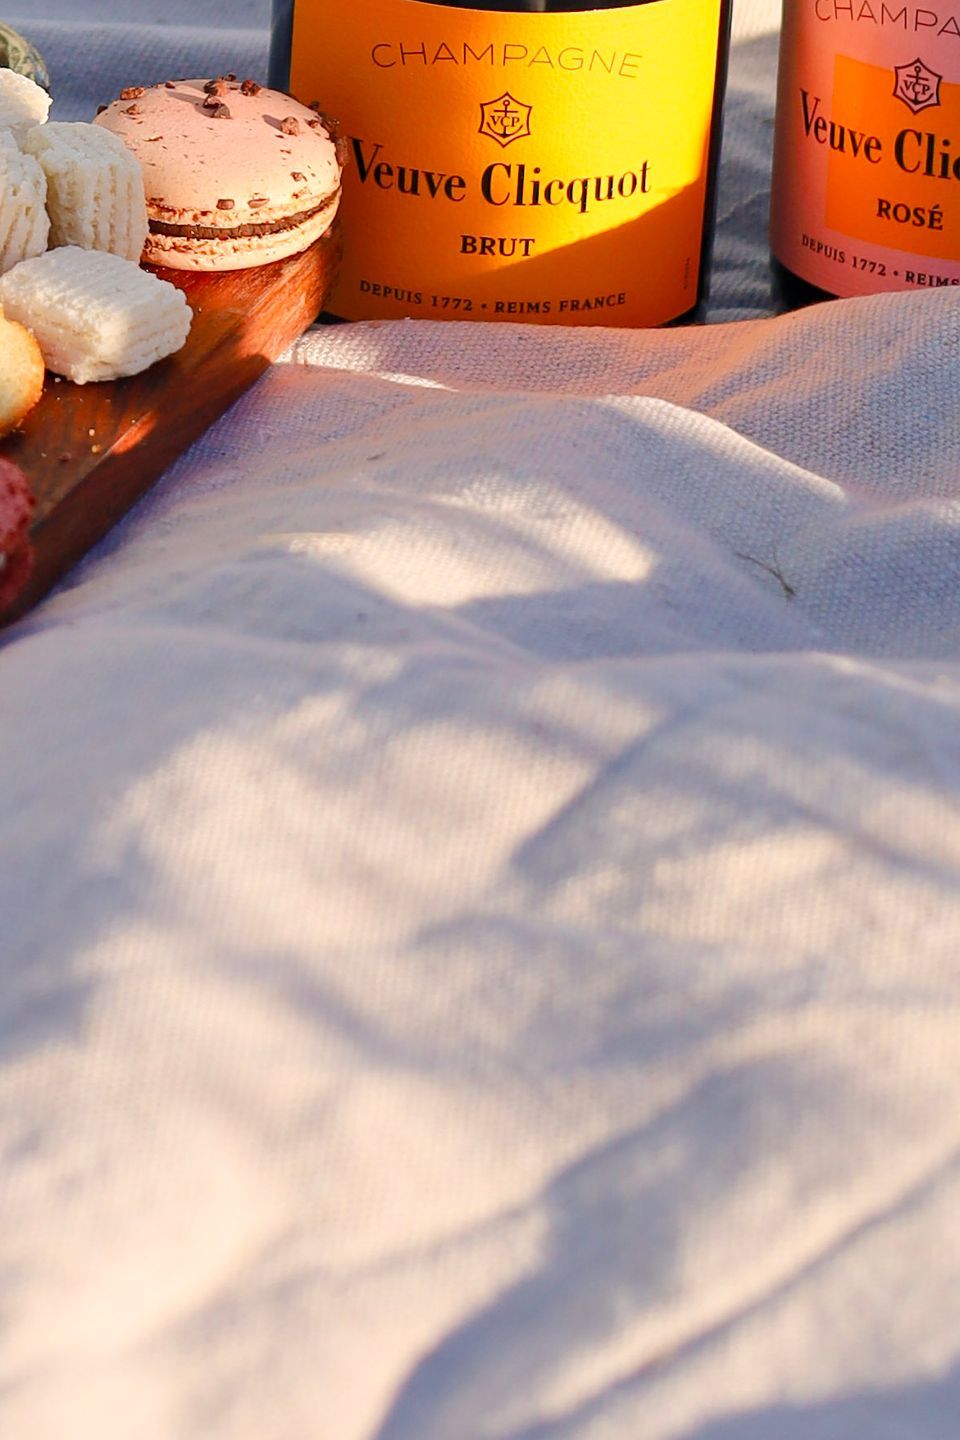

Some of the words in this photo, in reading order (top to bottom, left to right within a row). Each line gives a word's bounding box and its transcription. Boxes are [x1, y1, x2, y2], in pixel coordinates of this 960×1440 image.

[371, 42, 643, 78] CHAMPAGNE
[800, 88, 882, 164] Veuve
[348, 136, 466, 202] Veuve
[481, 160, 652, 214] Clicquot
[876, 198, 943, 231] ROSÉ
[460, 234, 535, 257] BRUT
[802, 233, 846, 264] DEPUIS
[851, 256, 887, 277] 1772
[360, 279, 423, 305] DEPUIS
[431, 295, 474, 312] 1772
[494, 301, 551, 314] REIMS
[559, 292, 627, 313] FRANCE
